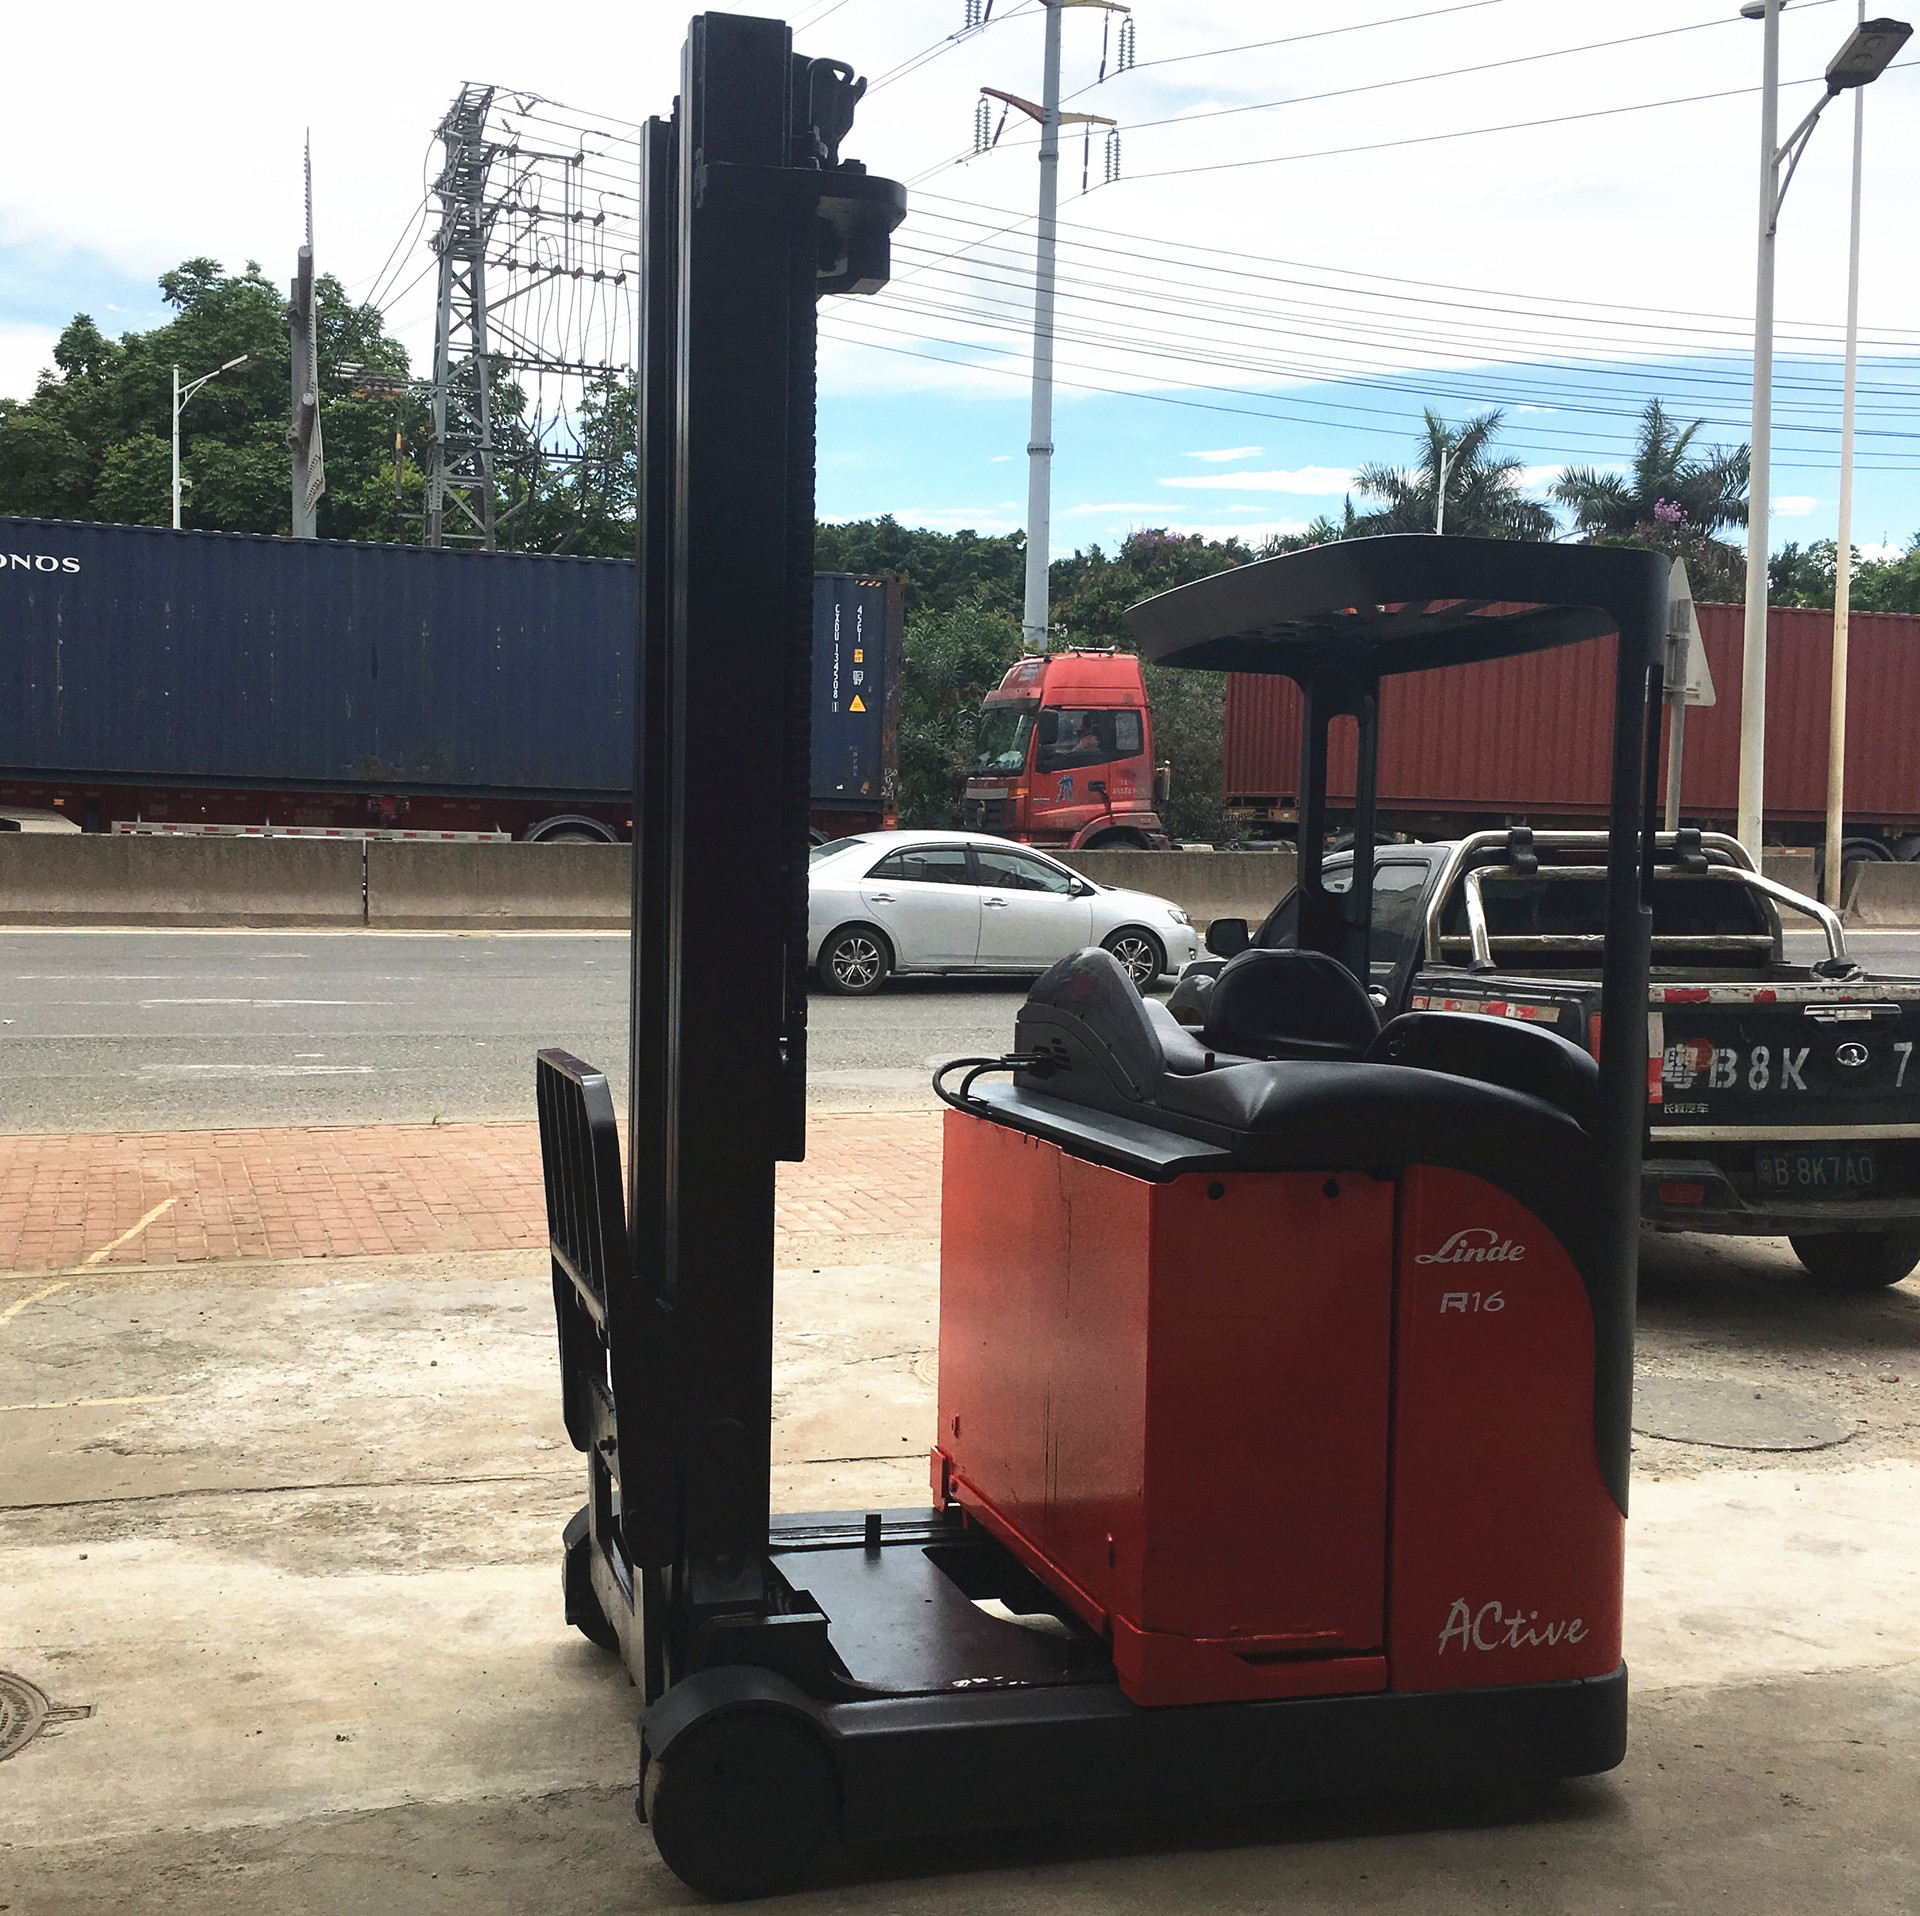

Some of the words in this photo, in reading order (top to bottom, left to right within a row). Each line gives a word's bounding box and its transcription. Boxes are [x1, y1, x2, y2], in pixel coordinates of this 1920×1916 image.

[1415, 1228, 1525, 1264] Linde
[1440, 1291, 1505, 1313] R16
[1439, 1598, 1589, 1655] ACtive
